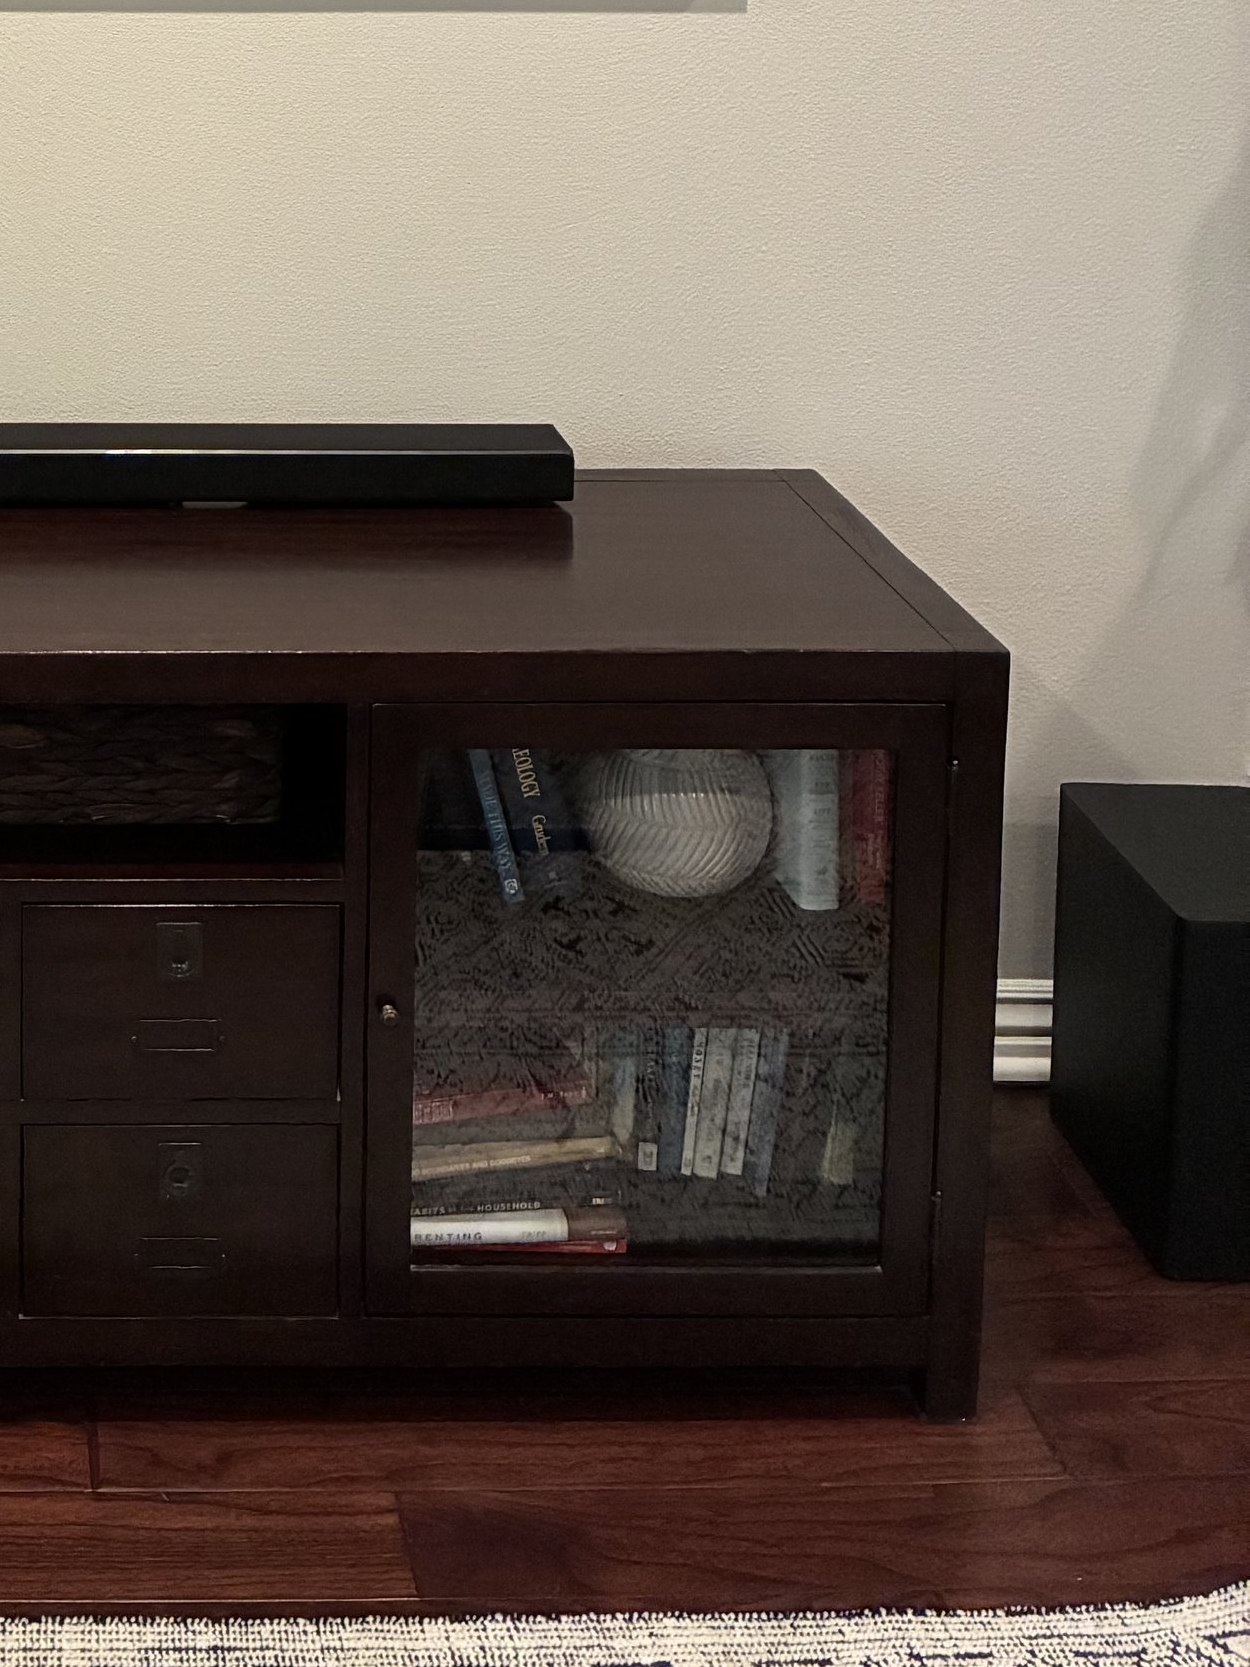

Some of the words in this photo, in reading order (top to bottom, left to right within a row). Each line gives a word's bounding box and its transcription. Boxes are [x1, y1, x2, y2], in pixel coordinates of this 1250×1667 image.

[512, 749, 540, 798] EOLOGY
[476, 1201, 541, 1212] HOUSEHOLD
[414, 1232, 482, 1242] RENTING
